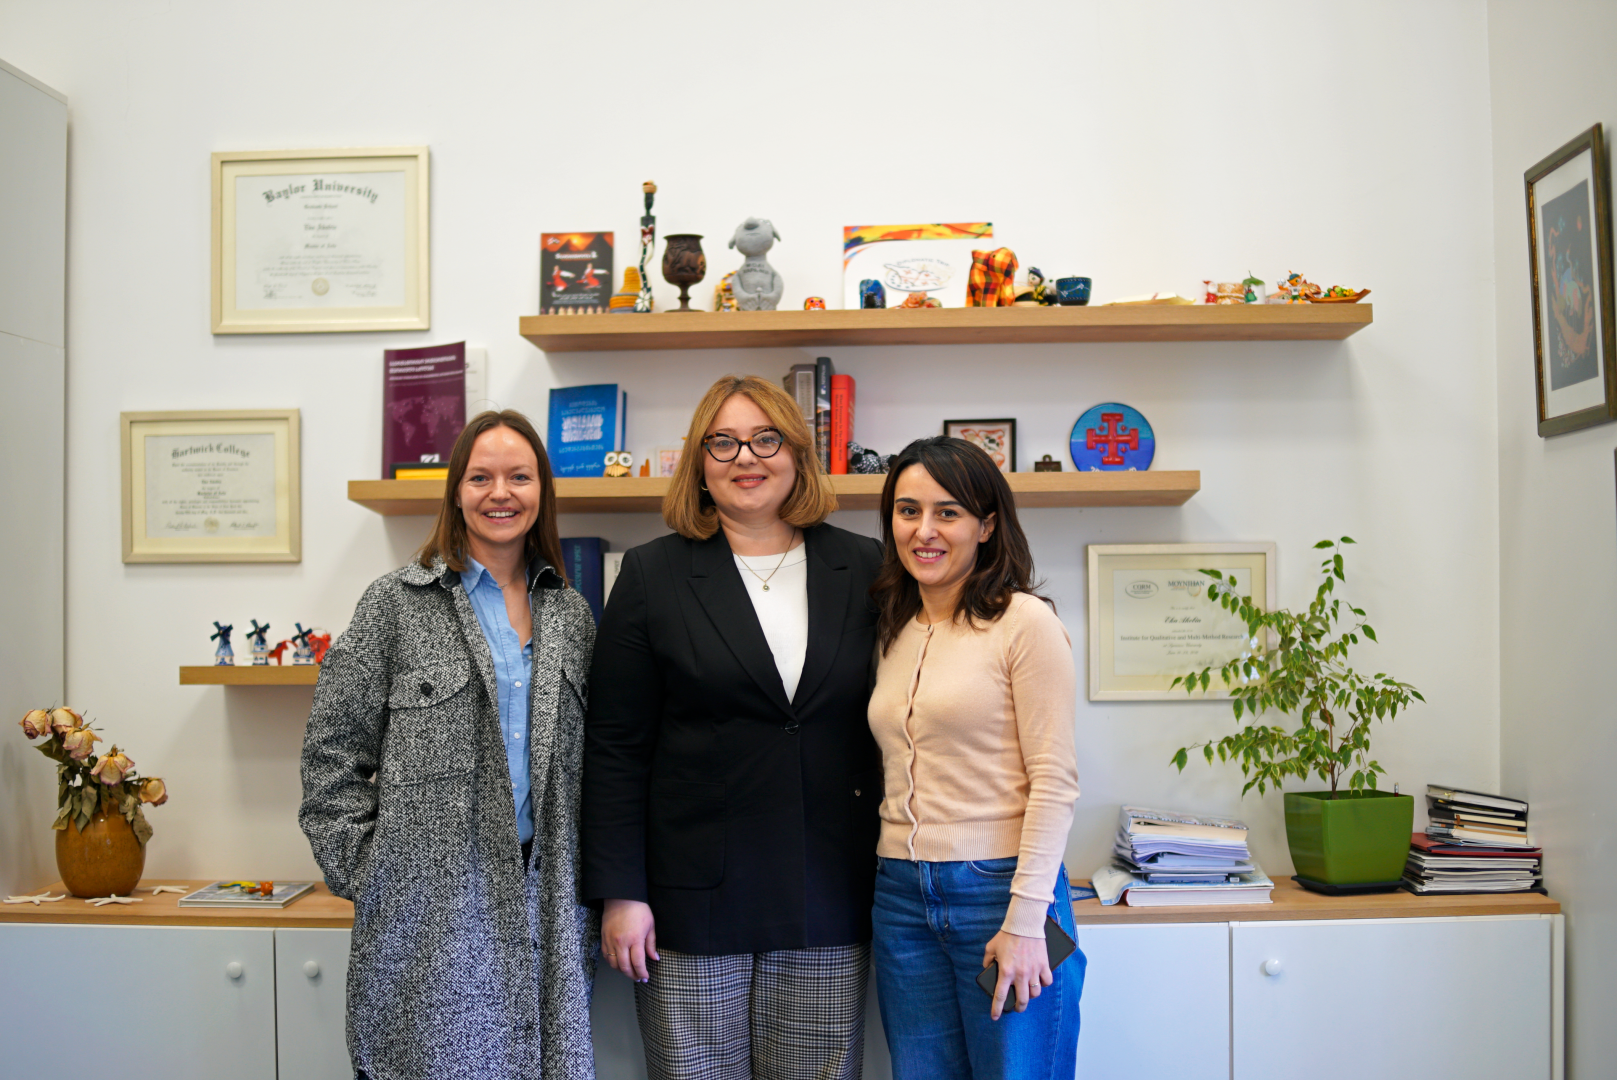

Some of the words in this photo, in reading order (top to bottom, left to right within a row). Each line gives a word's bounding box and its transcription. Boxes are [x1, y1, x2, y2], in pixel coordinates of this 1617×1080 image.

[262, 184, 306, 203] Baylor
[313, 179, 378, 203] University
[171, 443, 214, 460] Hartwick
[216, 442, 250, 459] College
